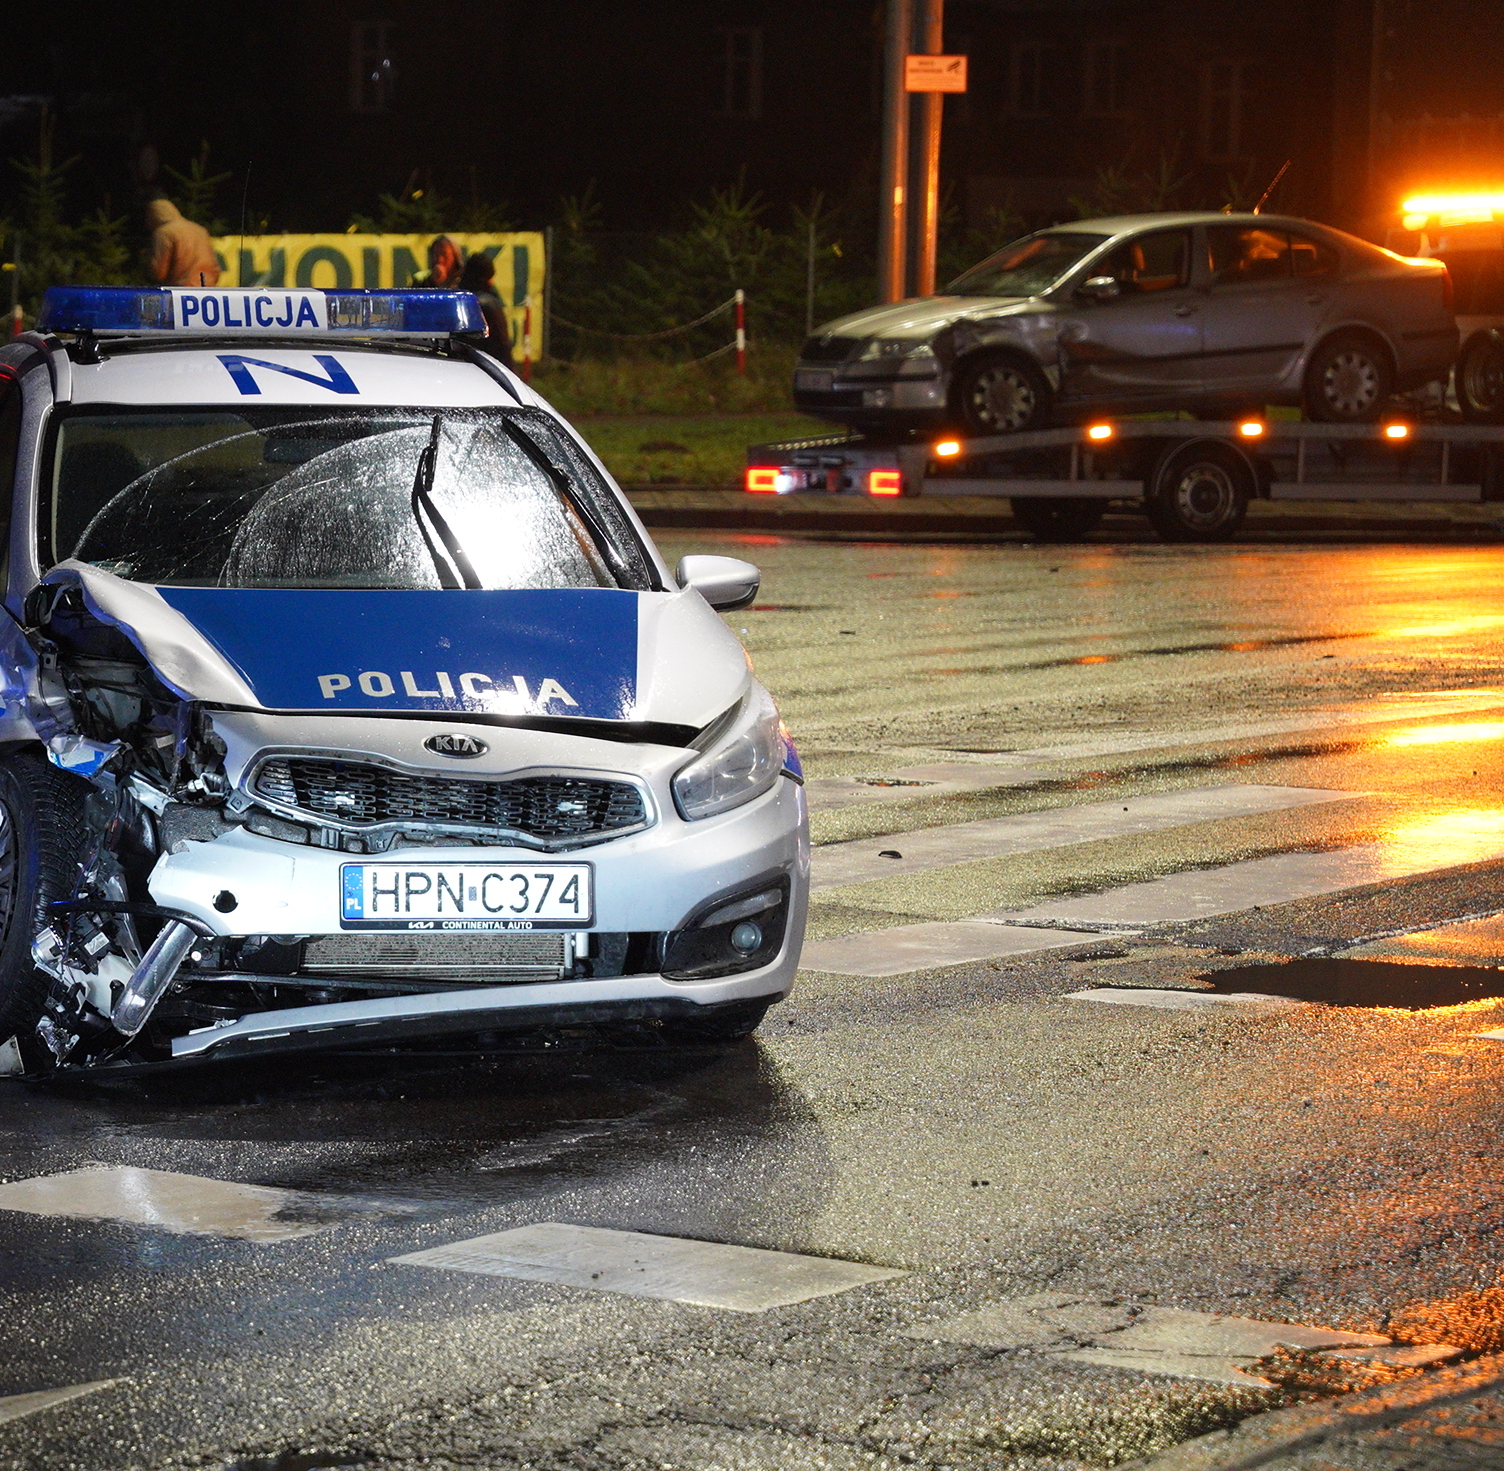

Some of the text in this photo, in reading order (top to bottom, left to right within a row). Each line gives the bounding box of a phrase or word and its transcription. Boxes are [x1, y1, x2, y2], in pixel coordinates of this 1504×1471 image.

[215, 245, 529, 306] HOINI
[181, 295, 320, 328] POLICJA
[215, 354, 361, 396] N
[317, 671, 580, 707] POLICJA
[435, 735, 479, 752] KIA
[346, 897, 362, 910] PL
[372, 871, 581, 914] HPN C374
[442, 921, 506, 930] CONTINENTAL
[507, 921, 533, 930] AUTO
